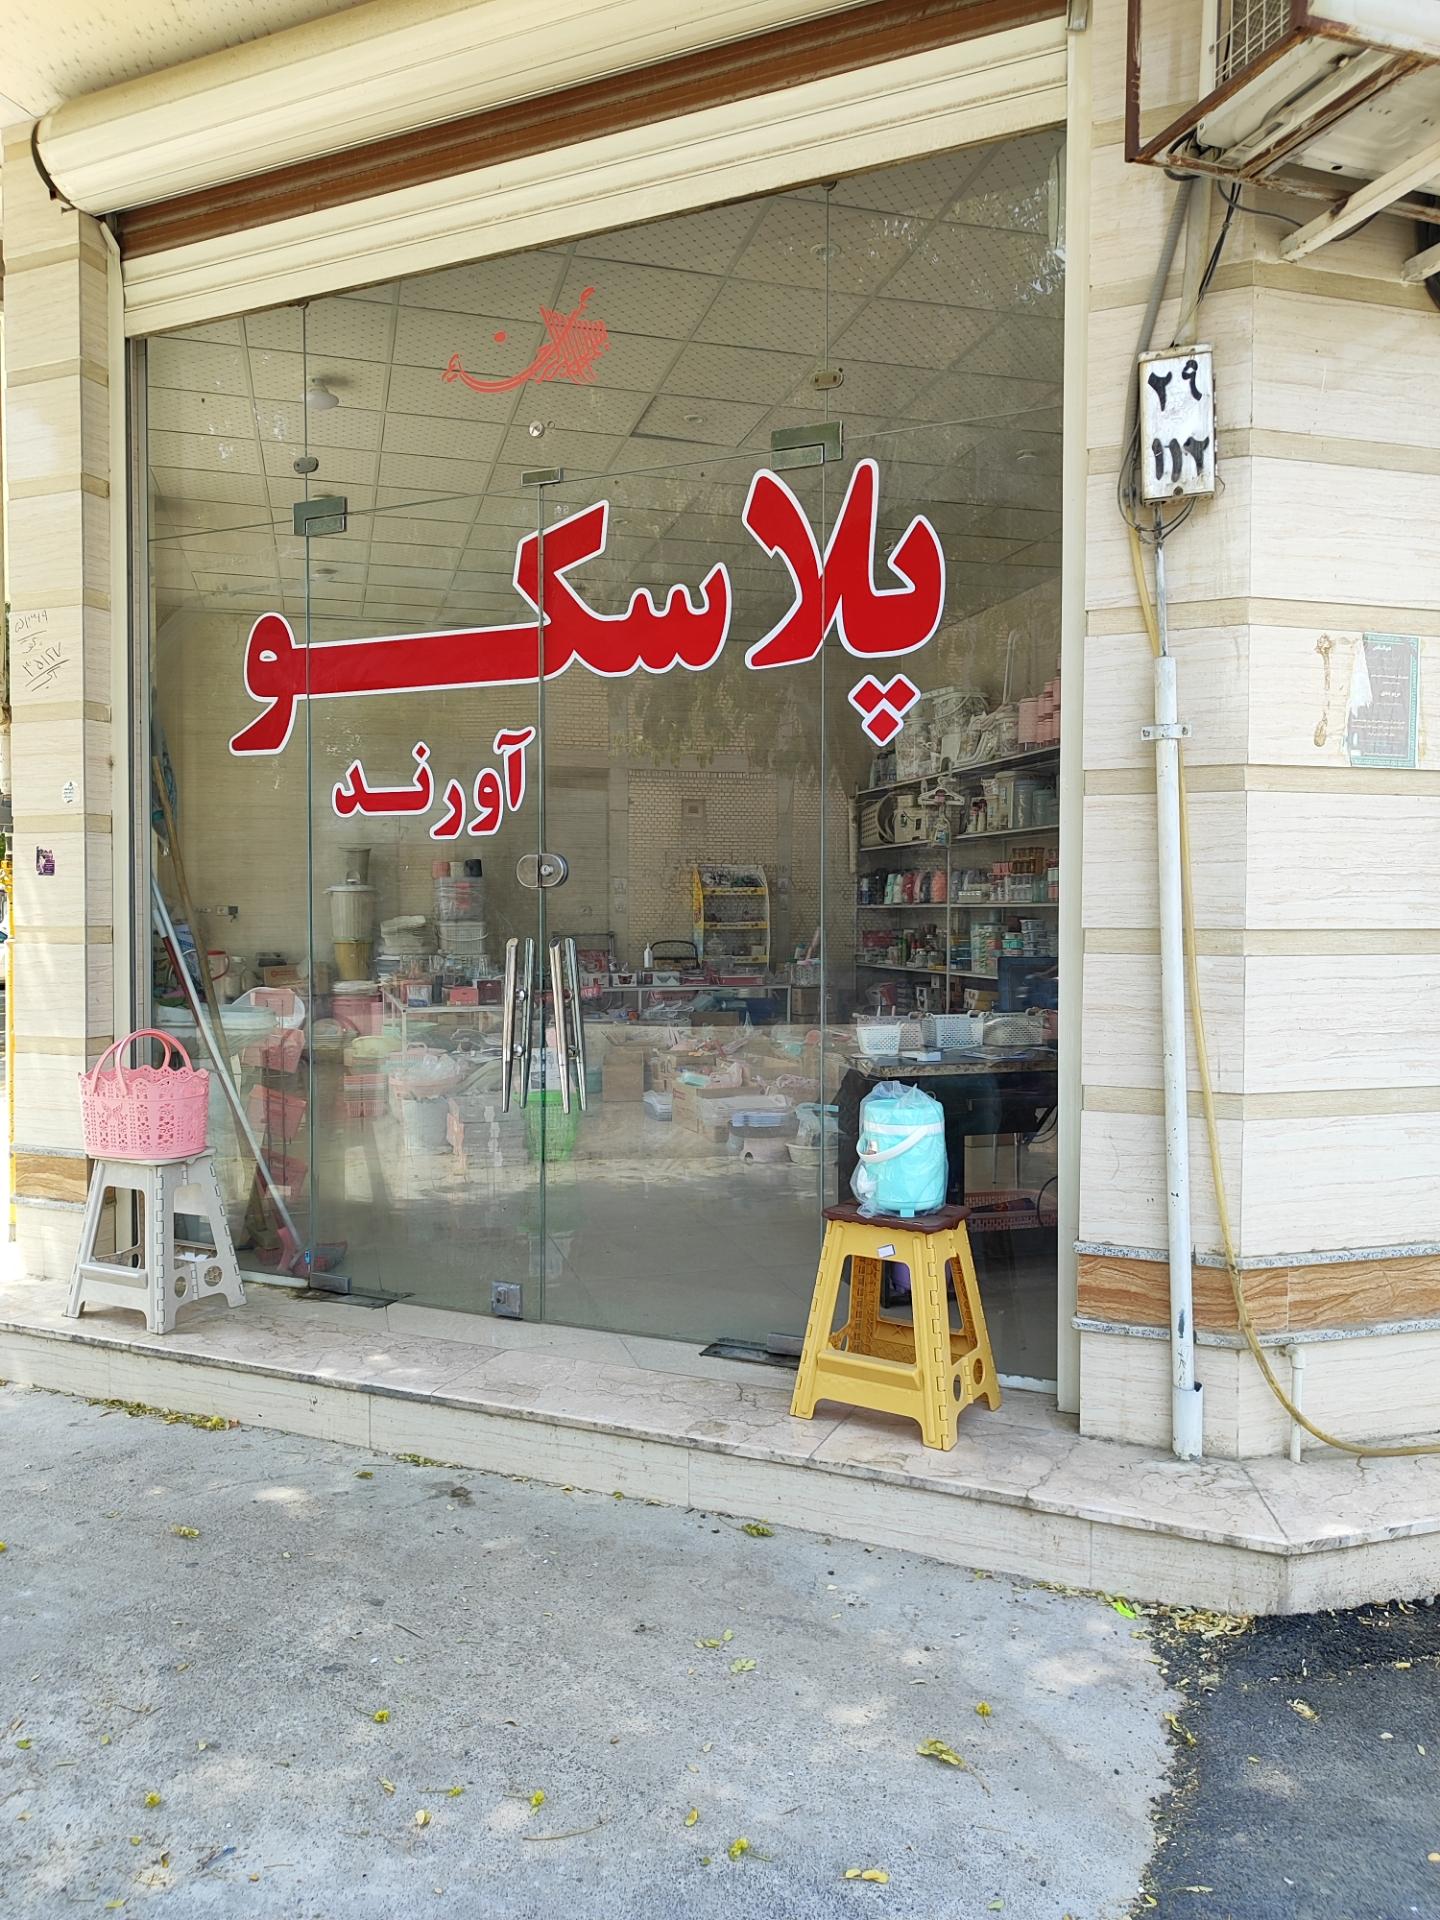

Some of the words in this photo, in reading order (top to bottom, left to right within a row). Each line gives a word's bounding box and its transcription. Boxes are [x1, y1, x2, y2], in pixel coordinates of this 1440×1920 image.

[1148, 360, 1203, 412] ۲۹
[1151, 437, 1210, 483] ۱۱۲
[229, 458, 946, 756] پلاسکو
[331, 725, 536, 840] آورند
